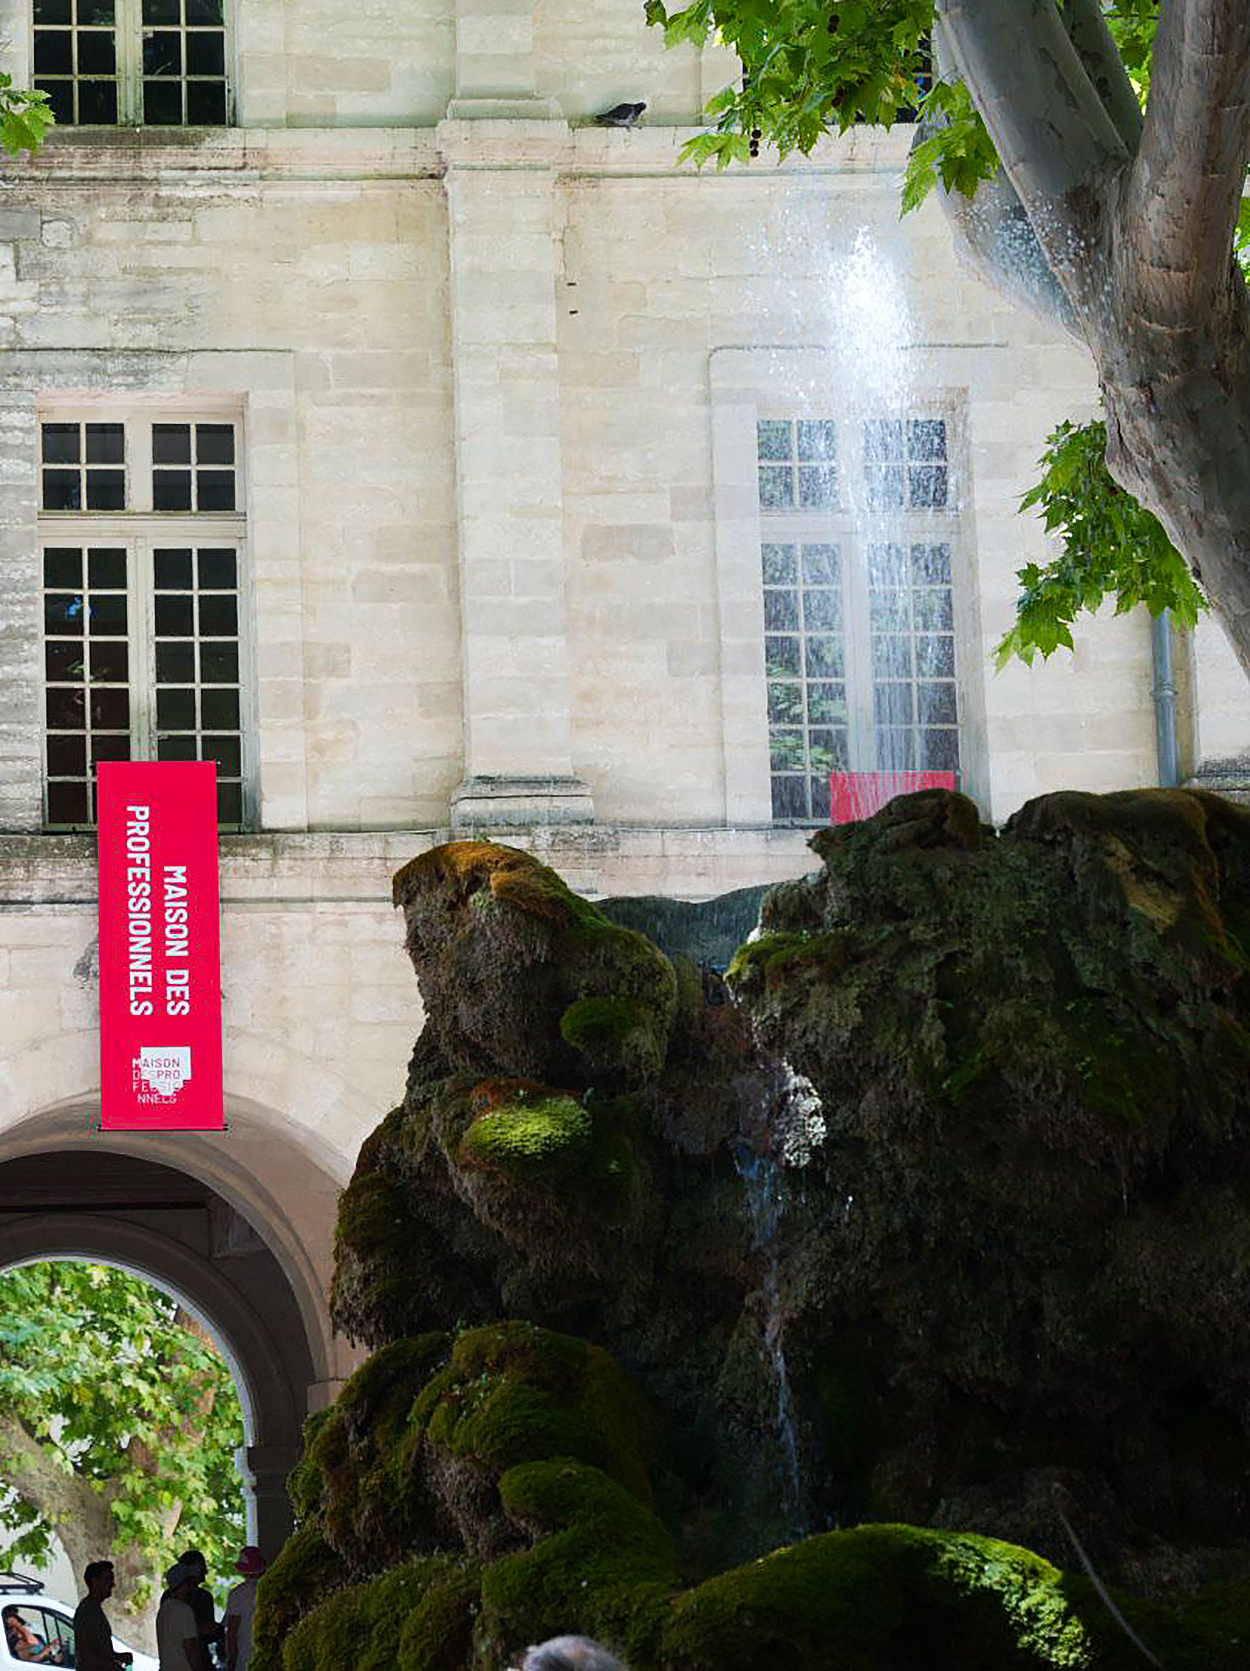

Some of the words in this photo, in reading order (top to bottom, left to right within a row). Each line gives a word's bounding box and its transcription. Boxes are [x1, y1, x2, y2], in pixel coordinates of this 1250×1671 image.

[126, 805, 154, 1016] PROFESSIONNELS
[163, 865, 189, 957] MAISON
[165, 969, 190, 1016] DES
